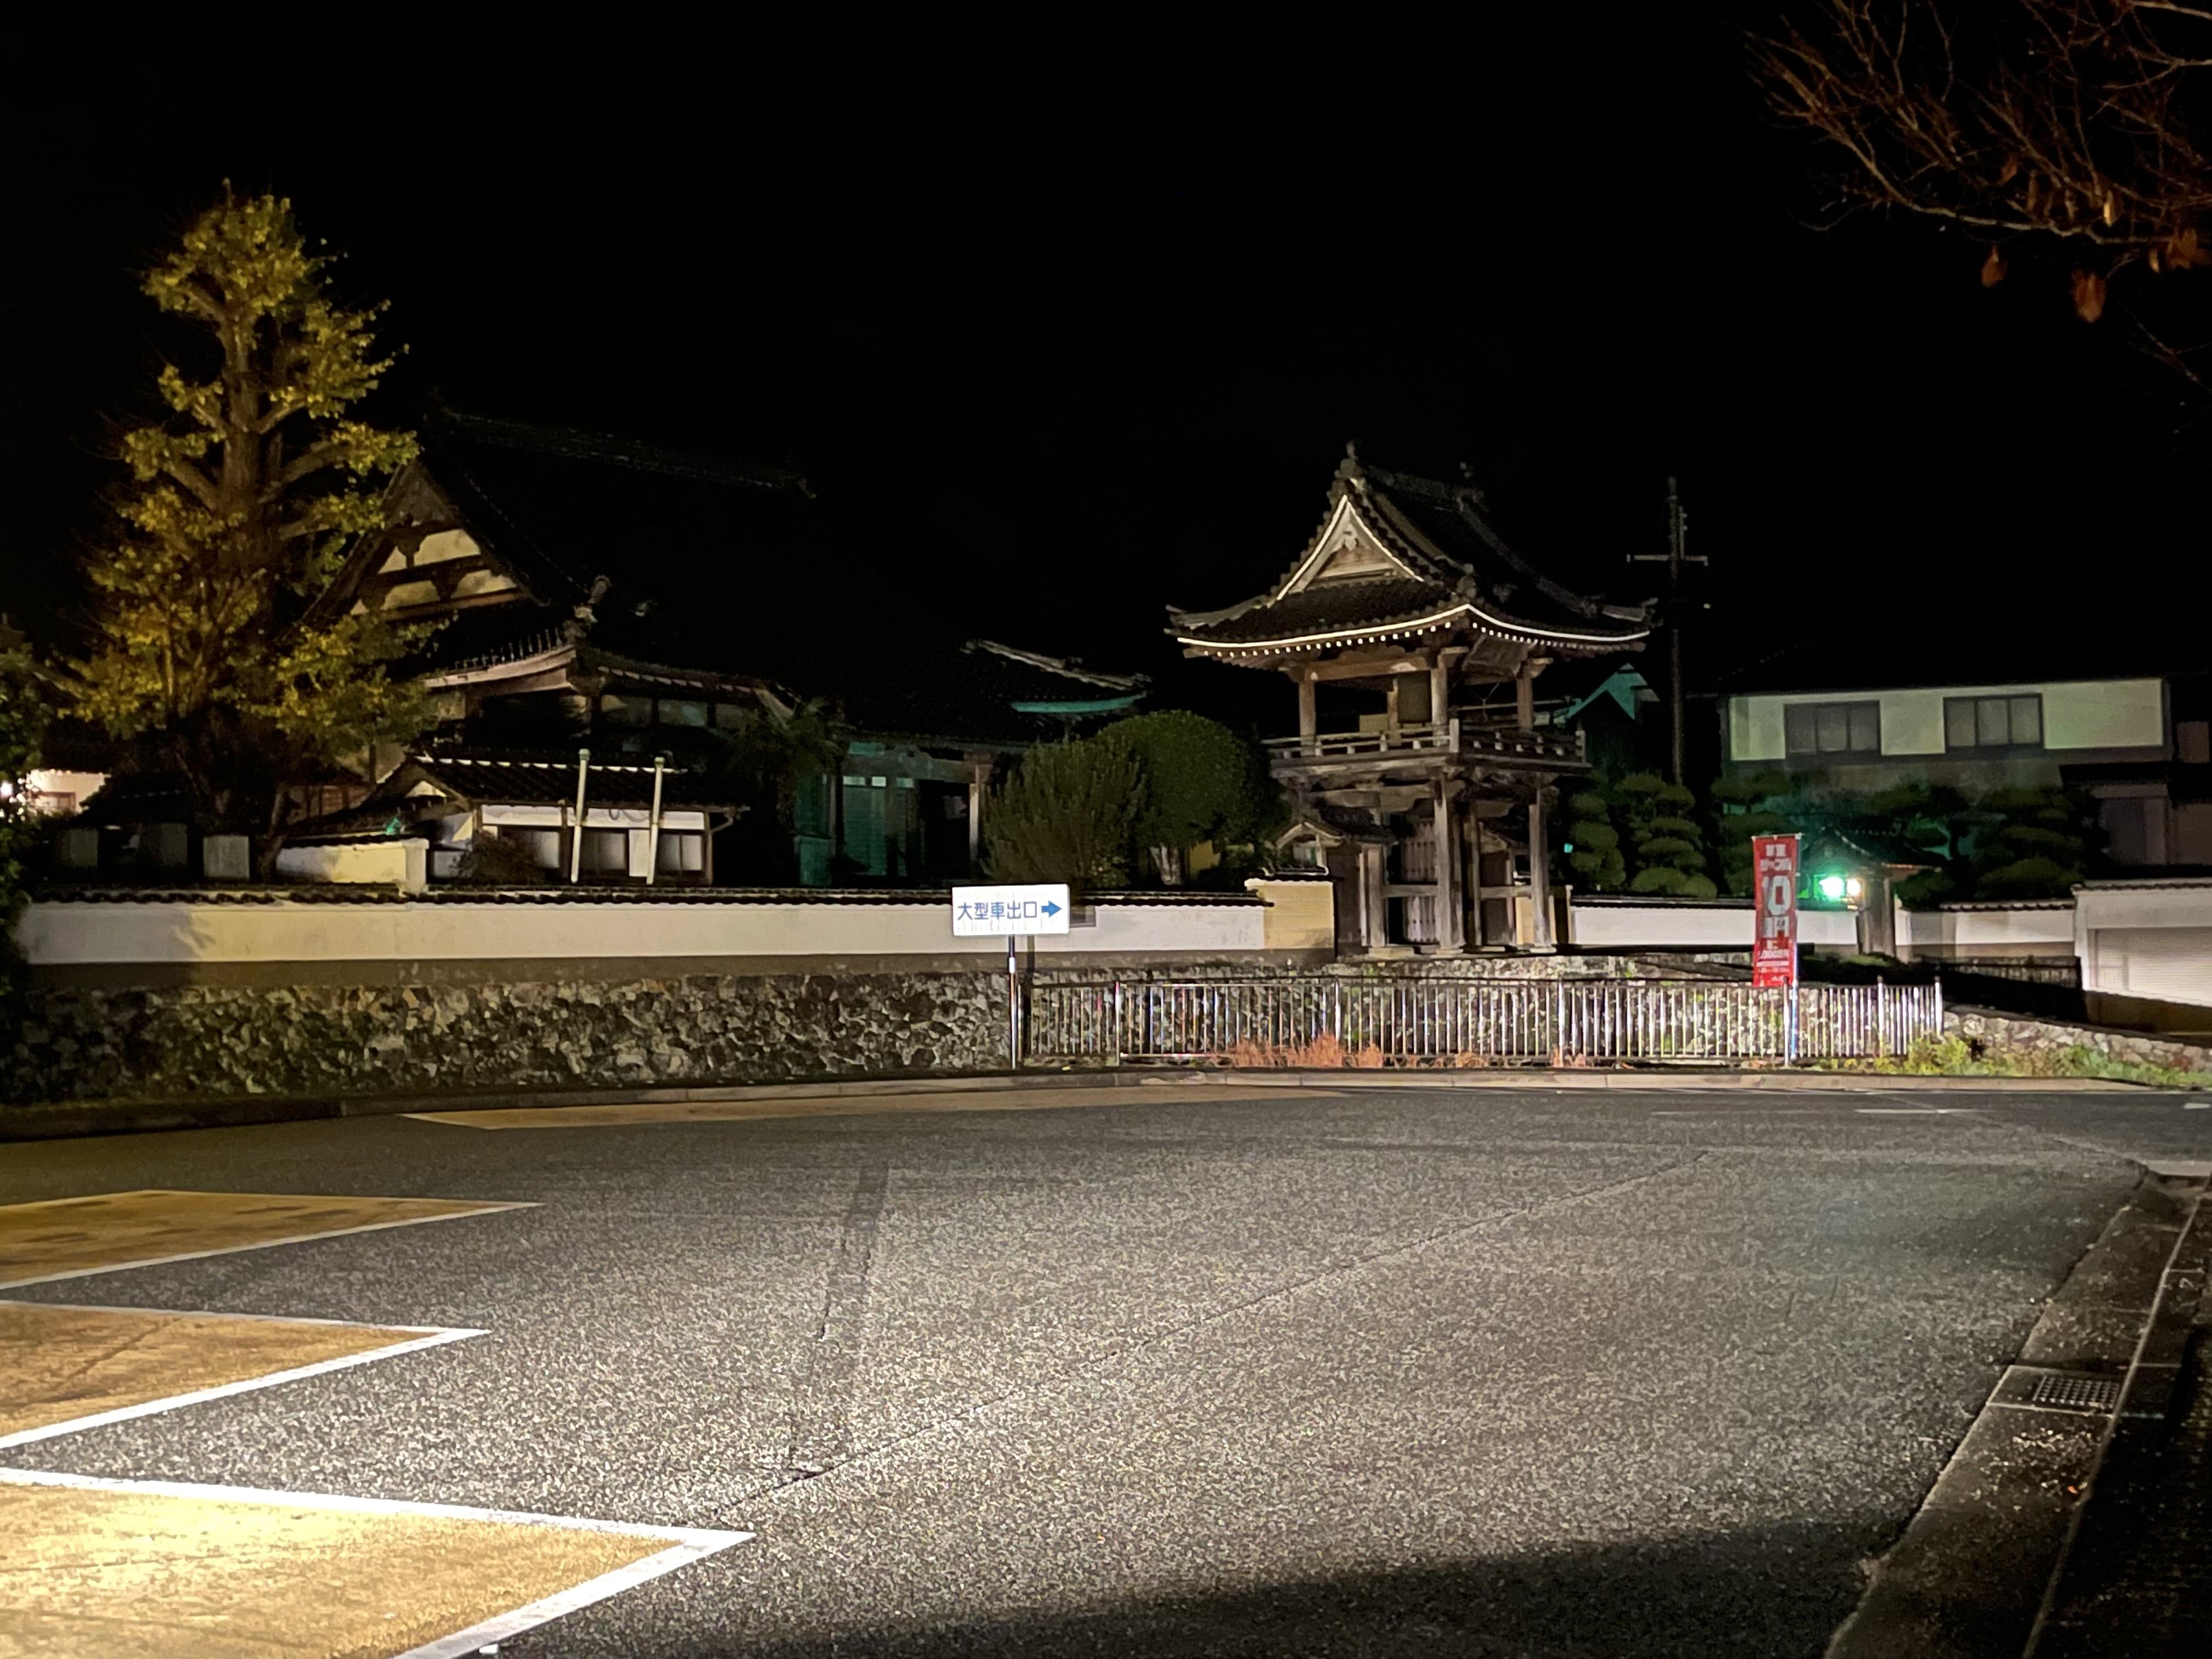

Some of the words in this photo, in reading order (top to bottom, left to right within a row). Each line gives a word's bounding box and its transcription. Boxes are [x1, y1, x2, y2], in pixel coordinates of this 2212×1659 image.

[957, 900, 1038, 921] 大型車出口
